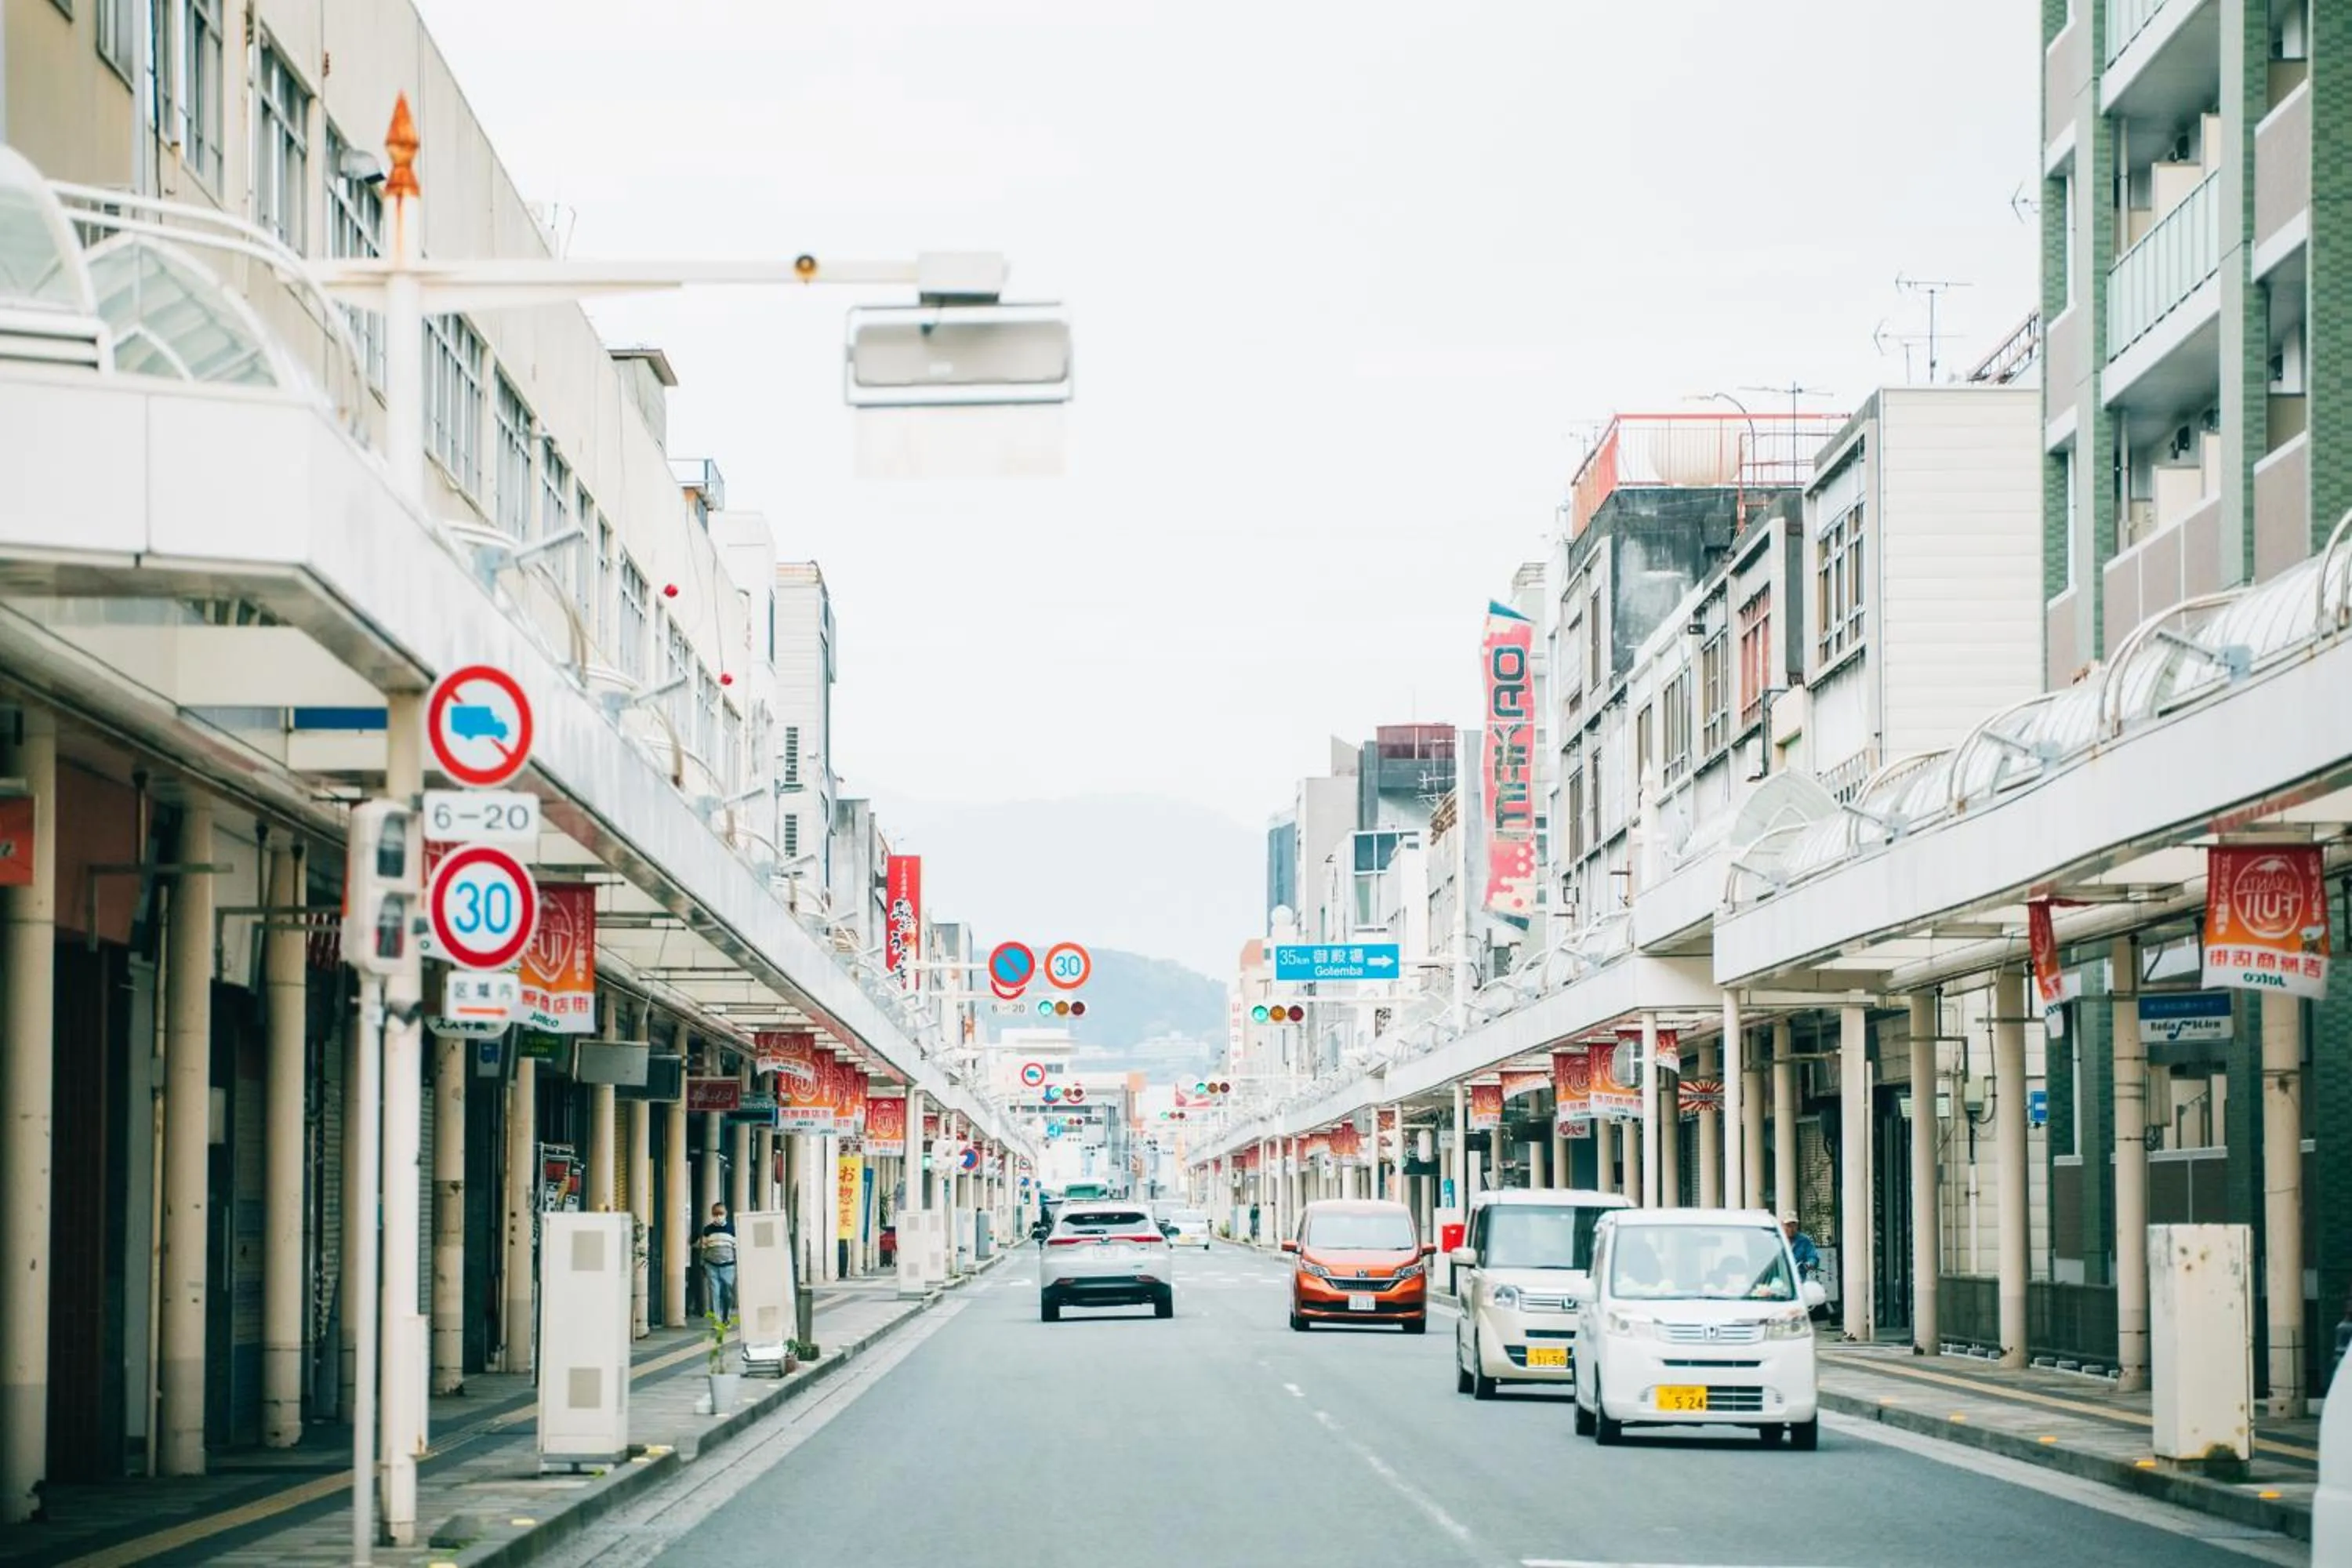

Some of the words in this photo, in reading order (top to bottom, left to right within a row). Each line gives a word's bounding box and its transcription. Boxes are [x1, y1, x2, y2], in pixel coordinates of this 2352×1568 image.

[434, 801, 530, 831] 6-20
[453, 880, 514, 935] 30
[1279, 949, 1310, 966] 35km
[1312, 947, 1365, 964] 御殿場
[1054, 955, 1082, 977] 30
[1314, 965, 1365, 977] Gotemba
[453, 981, 514, 1000] 区域内
[839, 1165, 857, 1227] お惣菜
